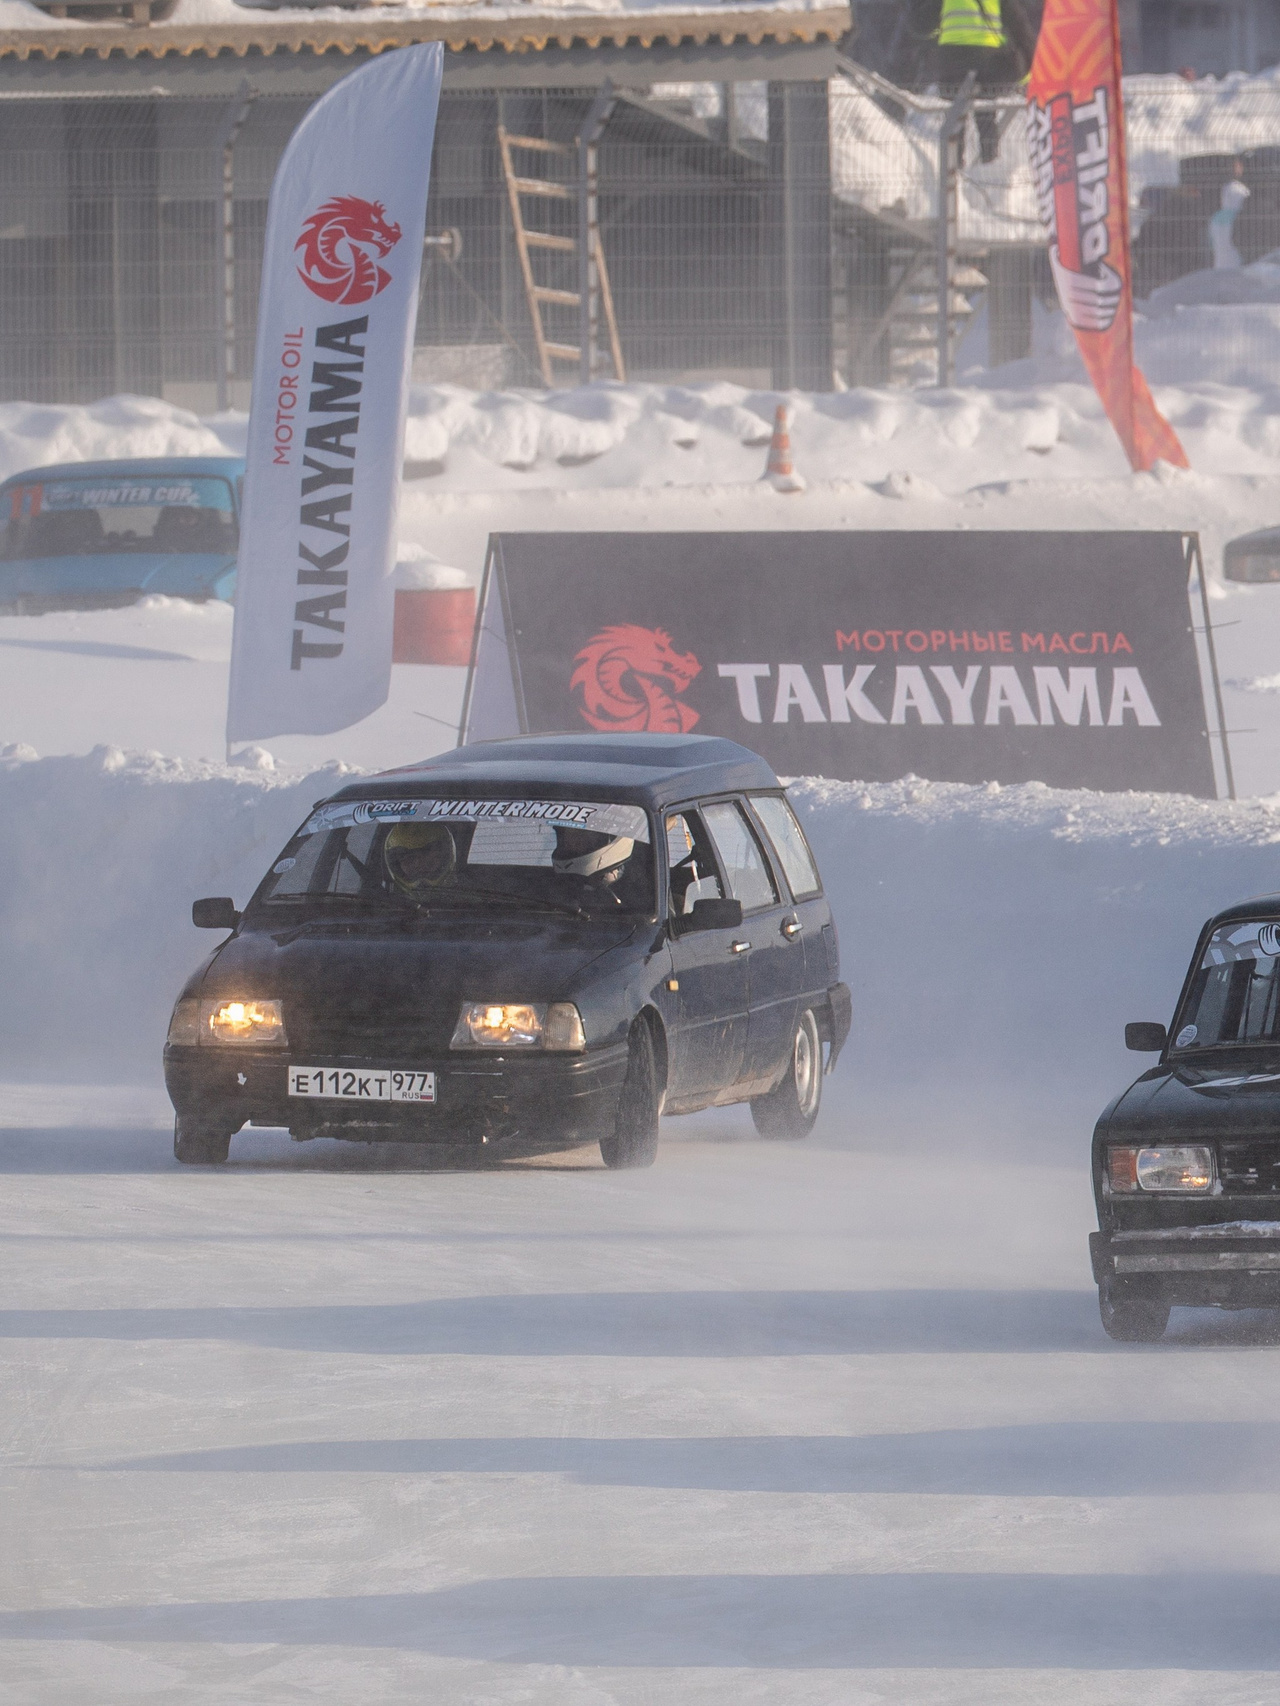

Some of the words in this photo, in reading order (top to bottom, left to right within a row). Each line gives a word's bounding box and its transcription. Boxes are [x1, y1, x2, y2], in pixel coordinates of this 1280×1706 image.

[281, 326, 304, 368] OIL
[273, 374, 299, 465] MOTOR
[290, 314, 369, 671] TAKAYAMA
[835, 630, 1014, 653] МОТОРНЫЕ
[1021, 632, 1133, 654] МАСЛА
[717, 663, 1162, 727] TAKAYAMA
[371, 802, 421, 812] DRIFT
[429, 801, 524, 817] WINTER
[525, 802, 596, 823] MODE
[392, 1072, 428, 1092] 977
[402, 1092, 420, 1100] RUS
